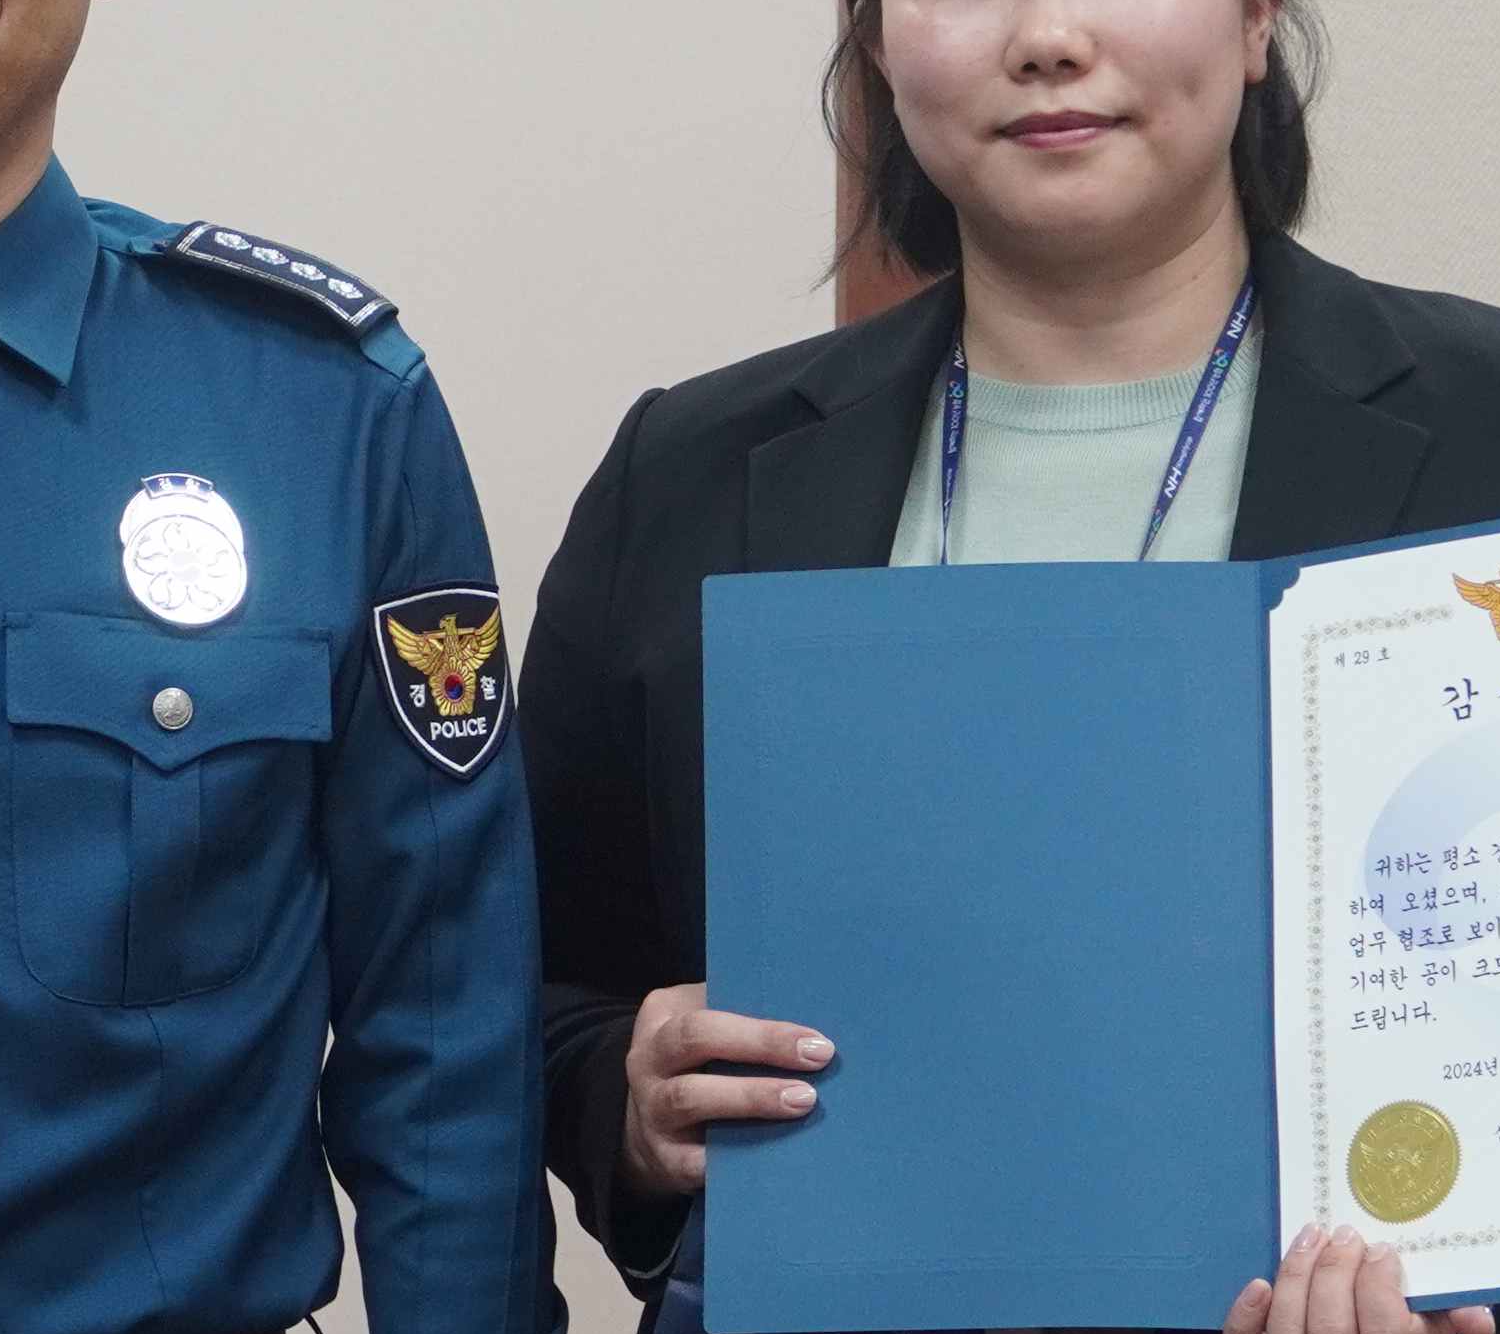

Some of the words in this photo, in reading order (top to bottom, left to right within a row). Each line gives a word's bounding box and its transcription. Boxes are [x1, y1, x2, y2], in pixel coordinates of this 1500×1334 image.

[1163, 466, 1182, 499] NH
[1334, 651, 1346, 668] 제
[1353, 649, 1370, 666] 29
[1376, 646, 1391, 662] 호
[429, 716, 487, 741] POLICE
[1374, 851, 1433, 879] 귀하는
[1442, 845, 1481, 872] 평소
[1348, 893, 1385, 920] 하여
[1401, 881, 1487, 913] 오셨으며,
[1348, 930, 1388, 959] 업무
[1396, 924, 1456, 952] 협조로
[1349, 965, 1409, 993] 기여한
[1420, 959, 1456, 987] 공이
[1350, 1000, 1437, 1031] 드립니다.
[1442, 1056, 1498, 1081] 2024년
